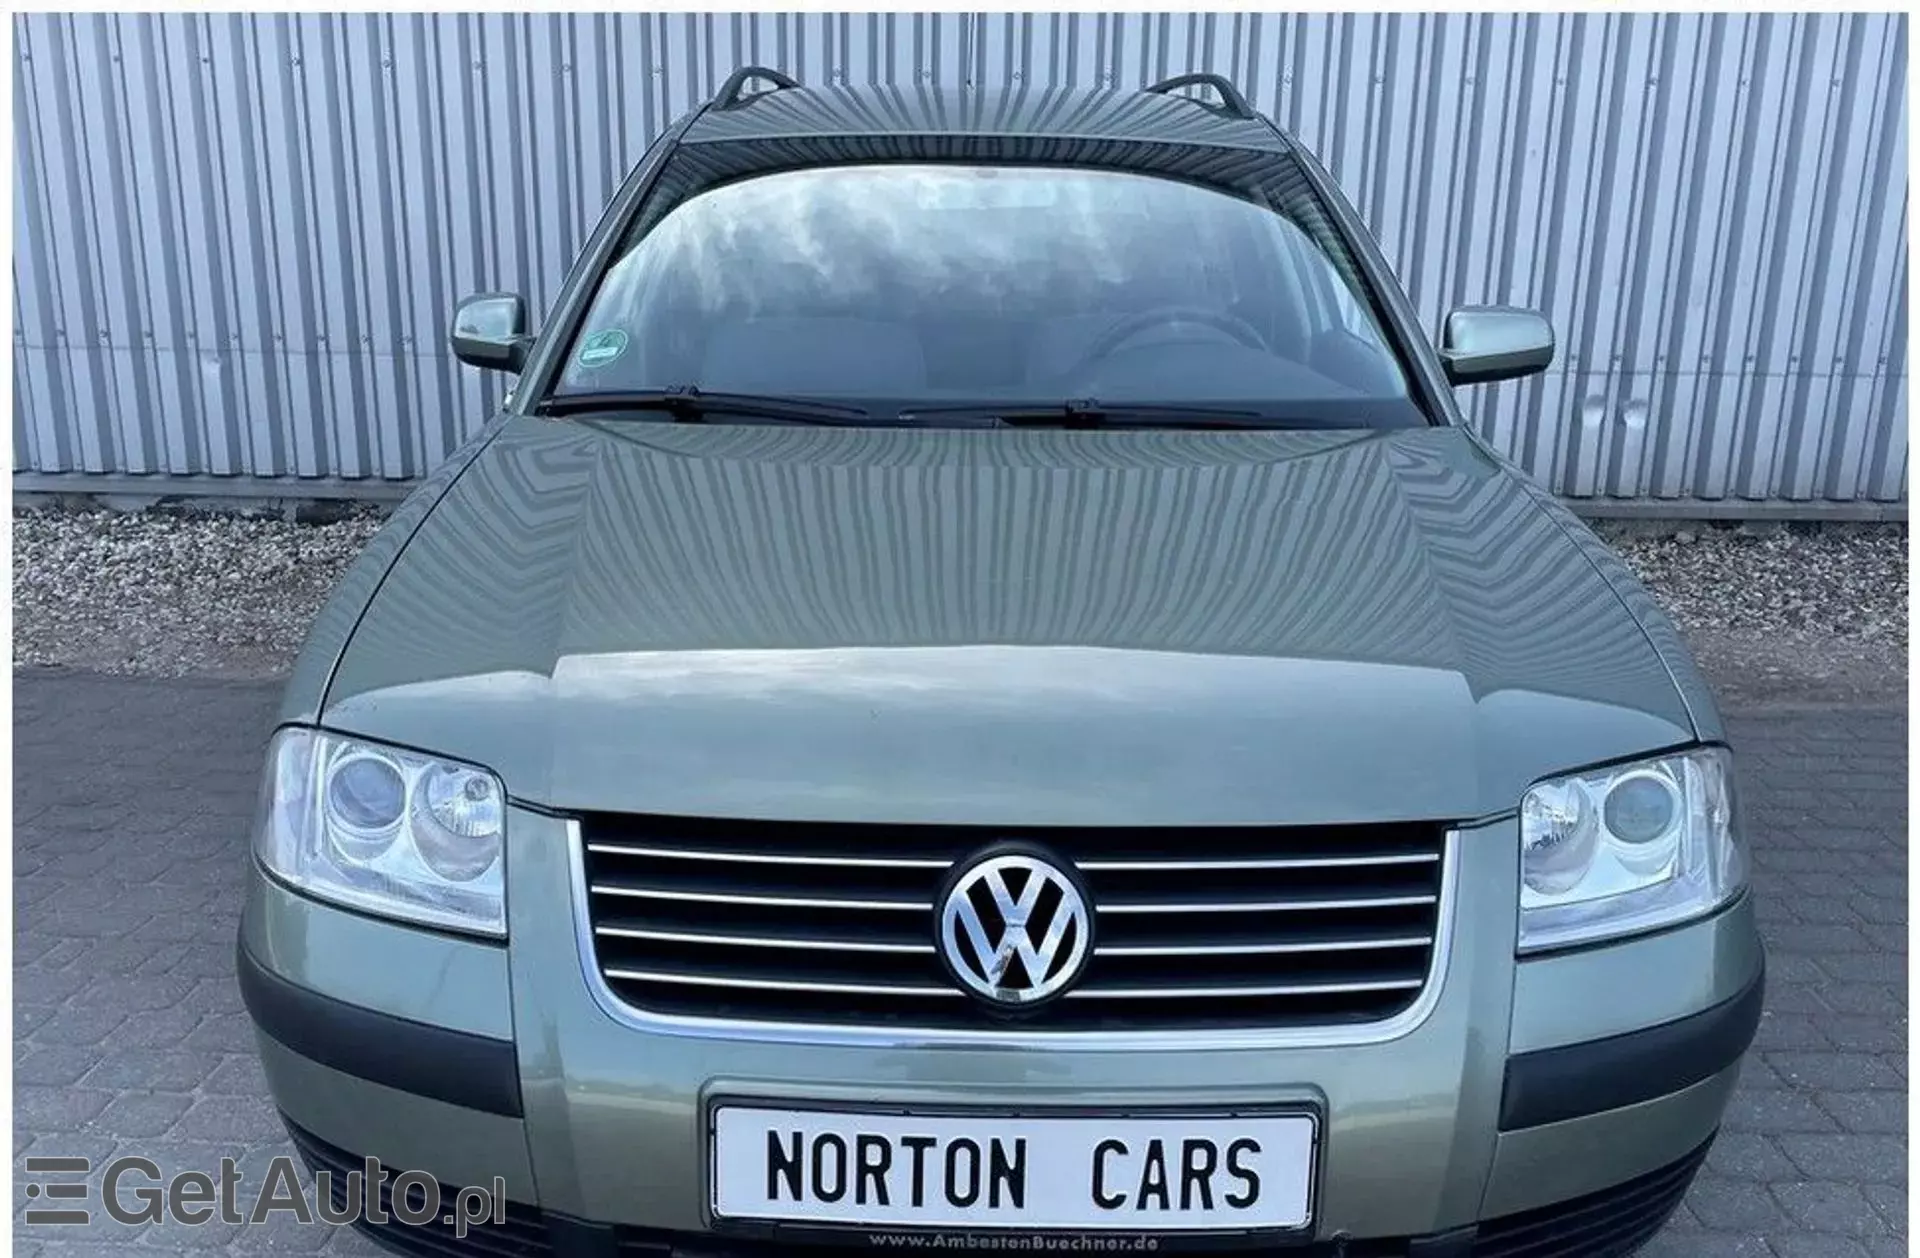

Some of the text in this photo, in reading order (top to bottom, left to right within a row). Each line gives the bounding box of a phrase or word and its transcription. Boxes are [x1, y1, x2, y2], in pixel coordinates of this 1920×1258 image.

[943, 856, 1088, 1000] VW
[766, 1129, 1262, 1210] NORTON CARS
[869, 1233, 1159, 1250] www.AmbestenBuechner.de
